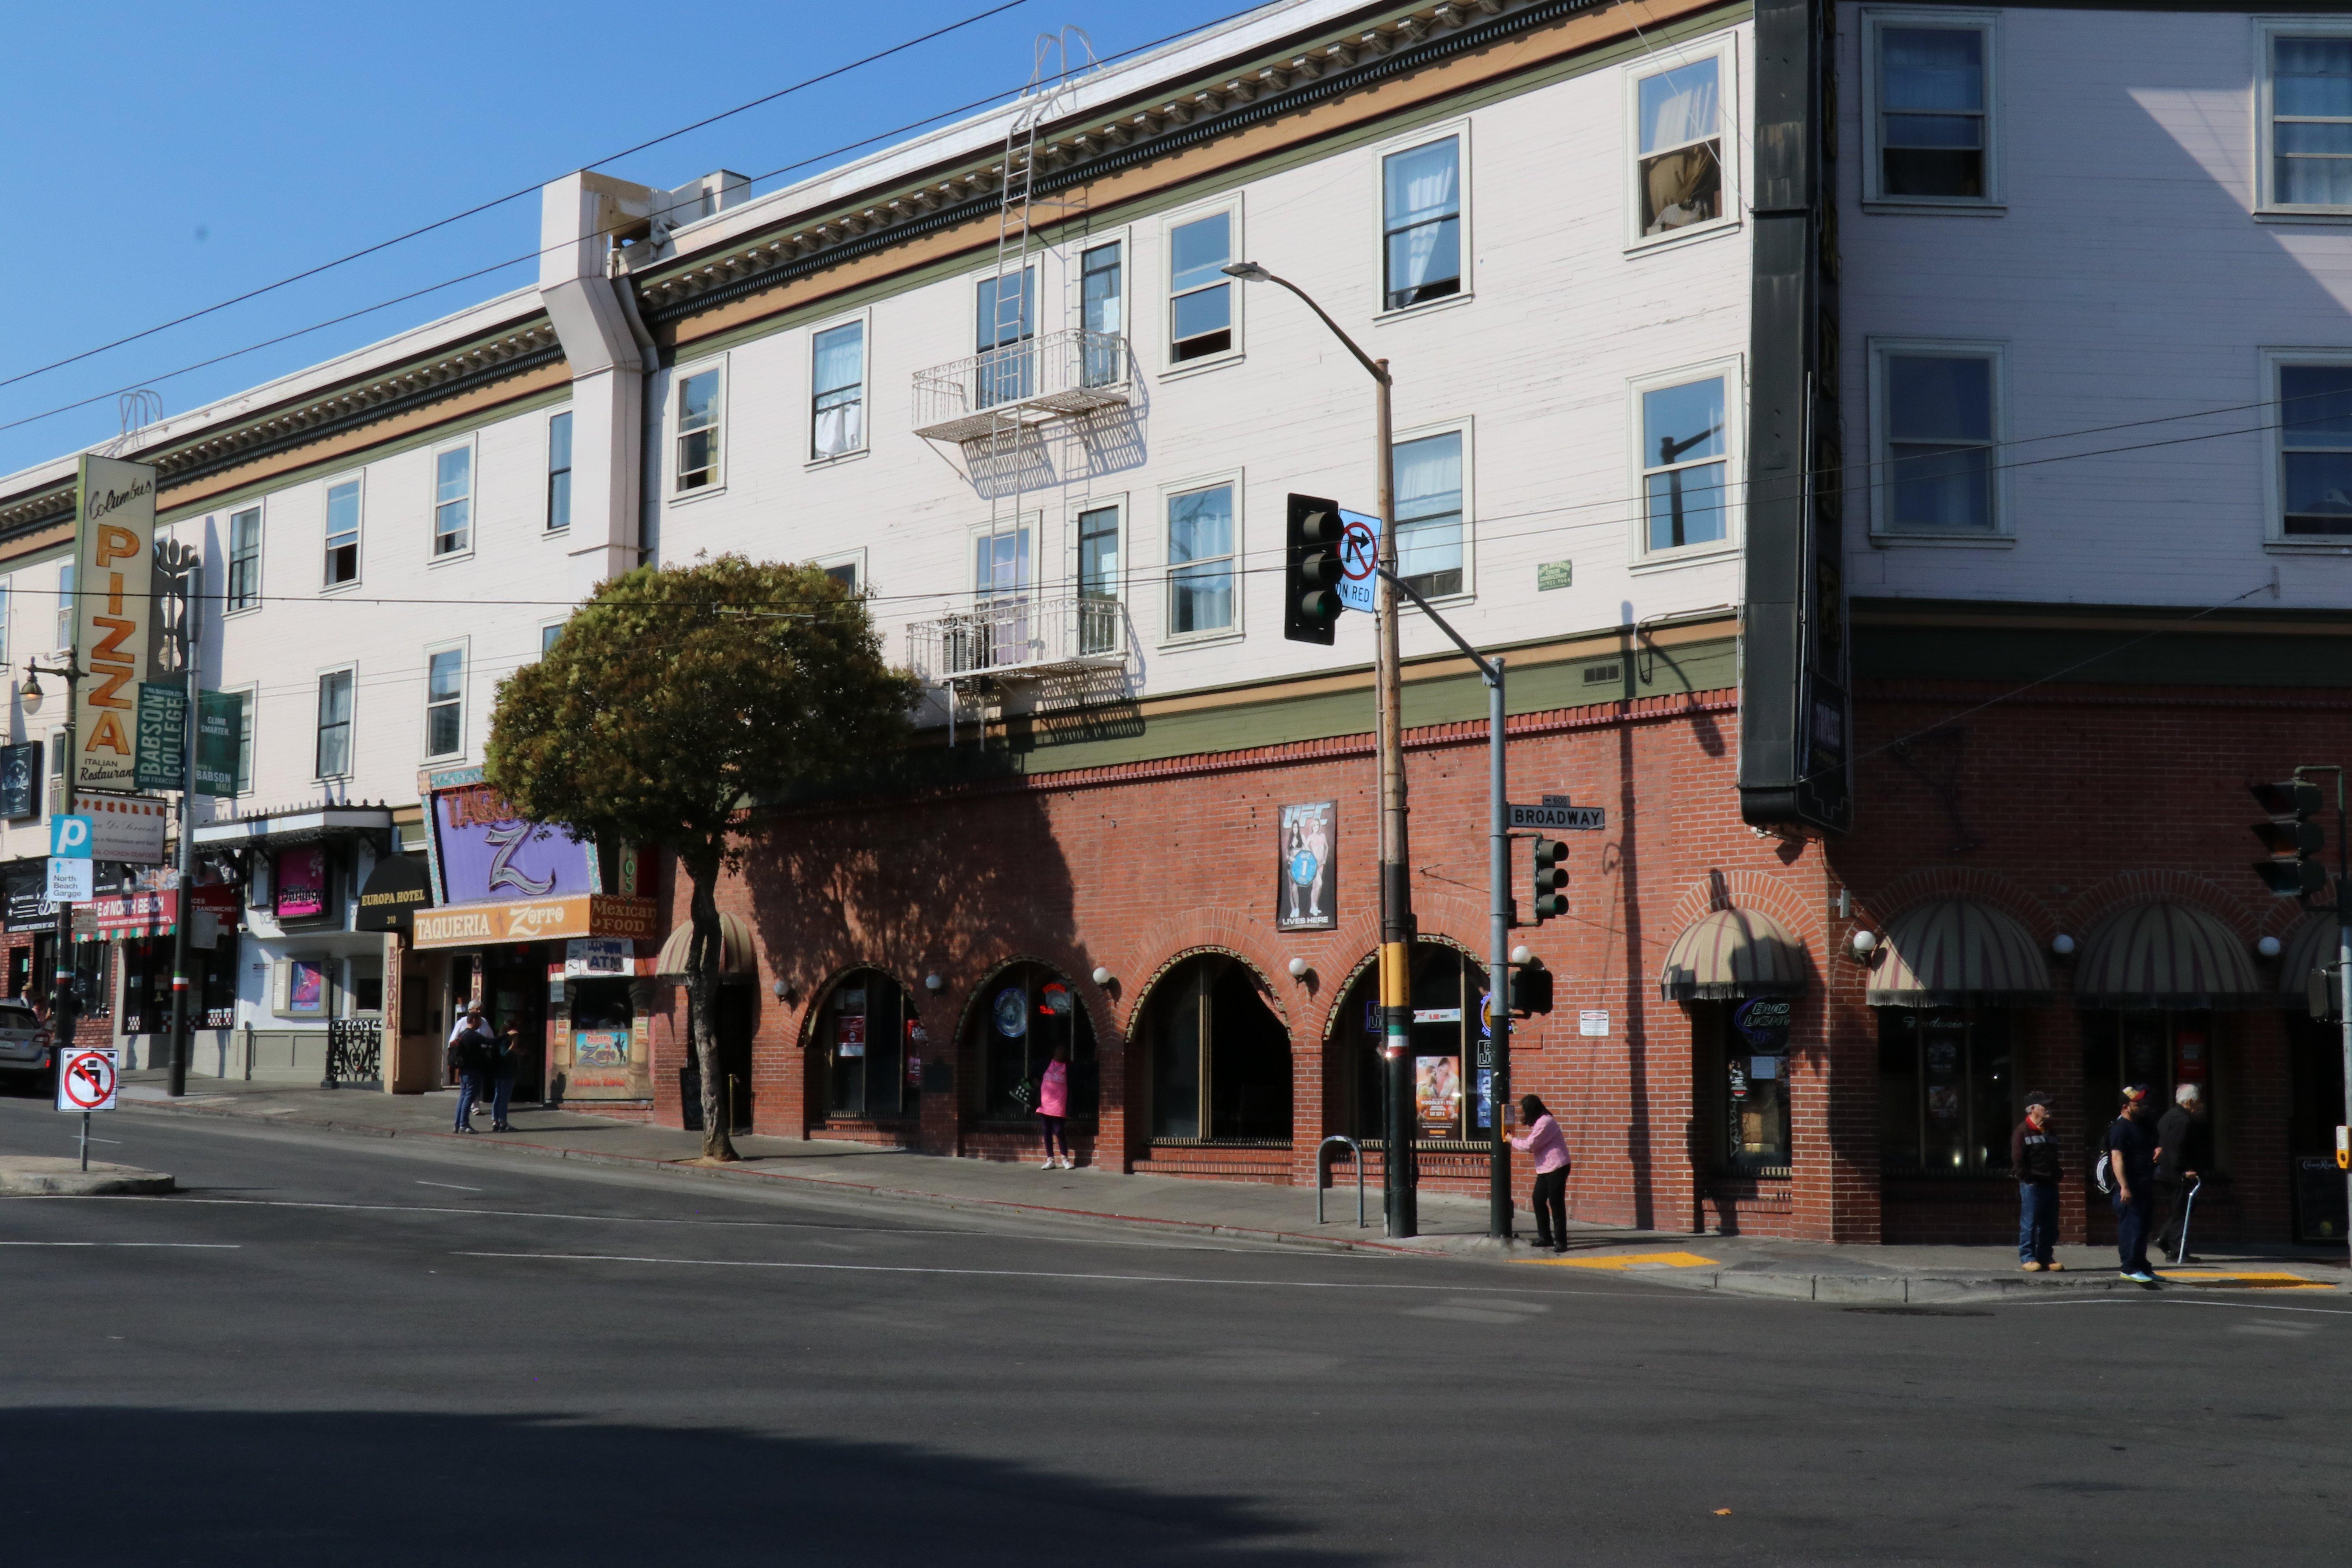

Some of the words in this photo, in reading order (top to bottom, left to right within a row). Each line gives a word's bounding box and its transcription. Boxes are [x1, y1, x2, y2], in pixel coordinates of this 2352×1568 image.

[89, 478, 152, 519] Columbus
[1539, 572, 1567, 582] CONSULTANT
[1336, 583, 1348, 598] ON
[1352, 586, 1369, 602] RED
[85, 524, 140, 755] PIZZA
[207, 716, 227, 726] CLIMB
[140, 694, 164, 775] BABSON
[162, 698, 183, 777] COLLEGE
[201, 725, 230, 735] SMARTER.
[85, 759, 118, 767] ITALIAN
[80, 767, 134, 781] Restaurant
[196, 770, 231, 783] BABSON
[216, 783, 231, 793] MBA
[1283, 802, 1330, 829] UFC
[1515, 809, 1599, 825] BROADWAY
[484, 822, 556, 896] Z
[53, 890, 82, 898] Garage
[361, 893, 395, 906] EUROPA
[397, 889, 425, 903] HOTEL
[110, 899, 136, 916] NORTH
[138, 896, 164, 914] BEACH
[415, 913, 491, 940] TAQUERIA
[508, 905, 564, 936] Zorro
[591, 901, 657, 929] Mexican
[1282, 917, 1306, 926] LIVES
[603, 918, 645, 933] FOOD
[590, 955, 622, 969] ATM
[386, 946, 396, 1030] EUROPA
[1752, 1002, 1790, 1014] BUD
[1743, 1014, 1790, 1027] LIGHT
